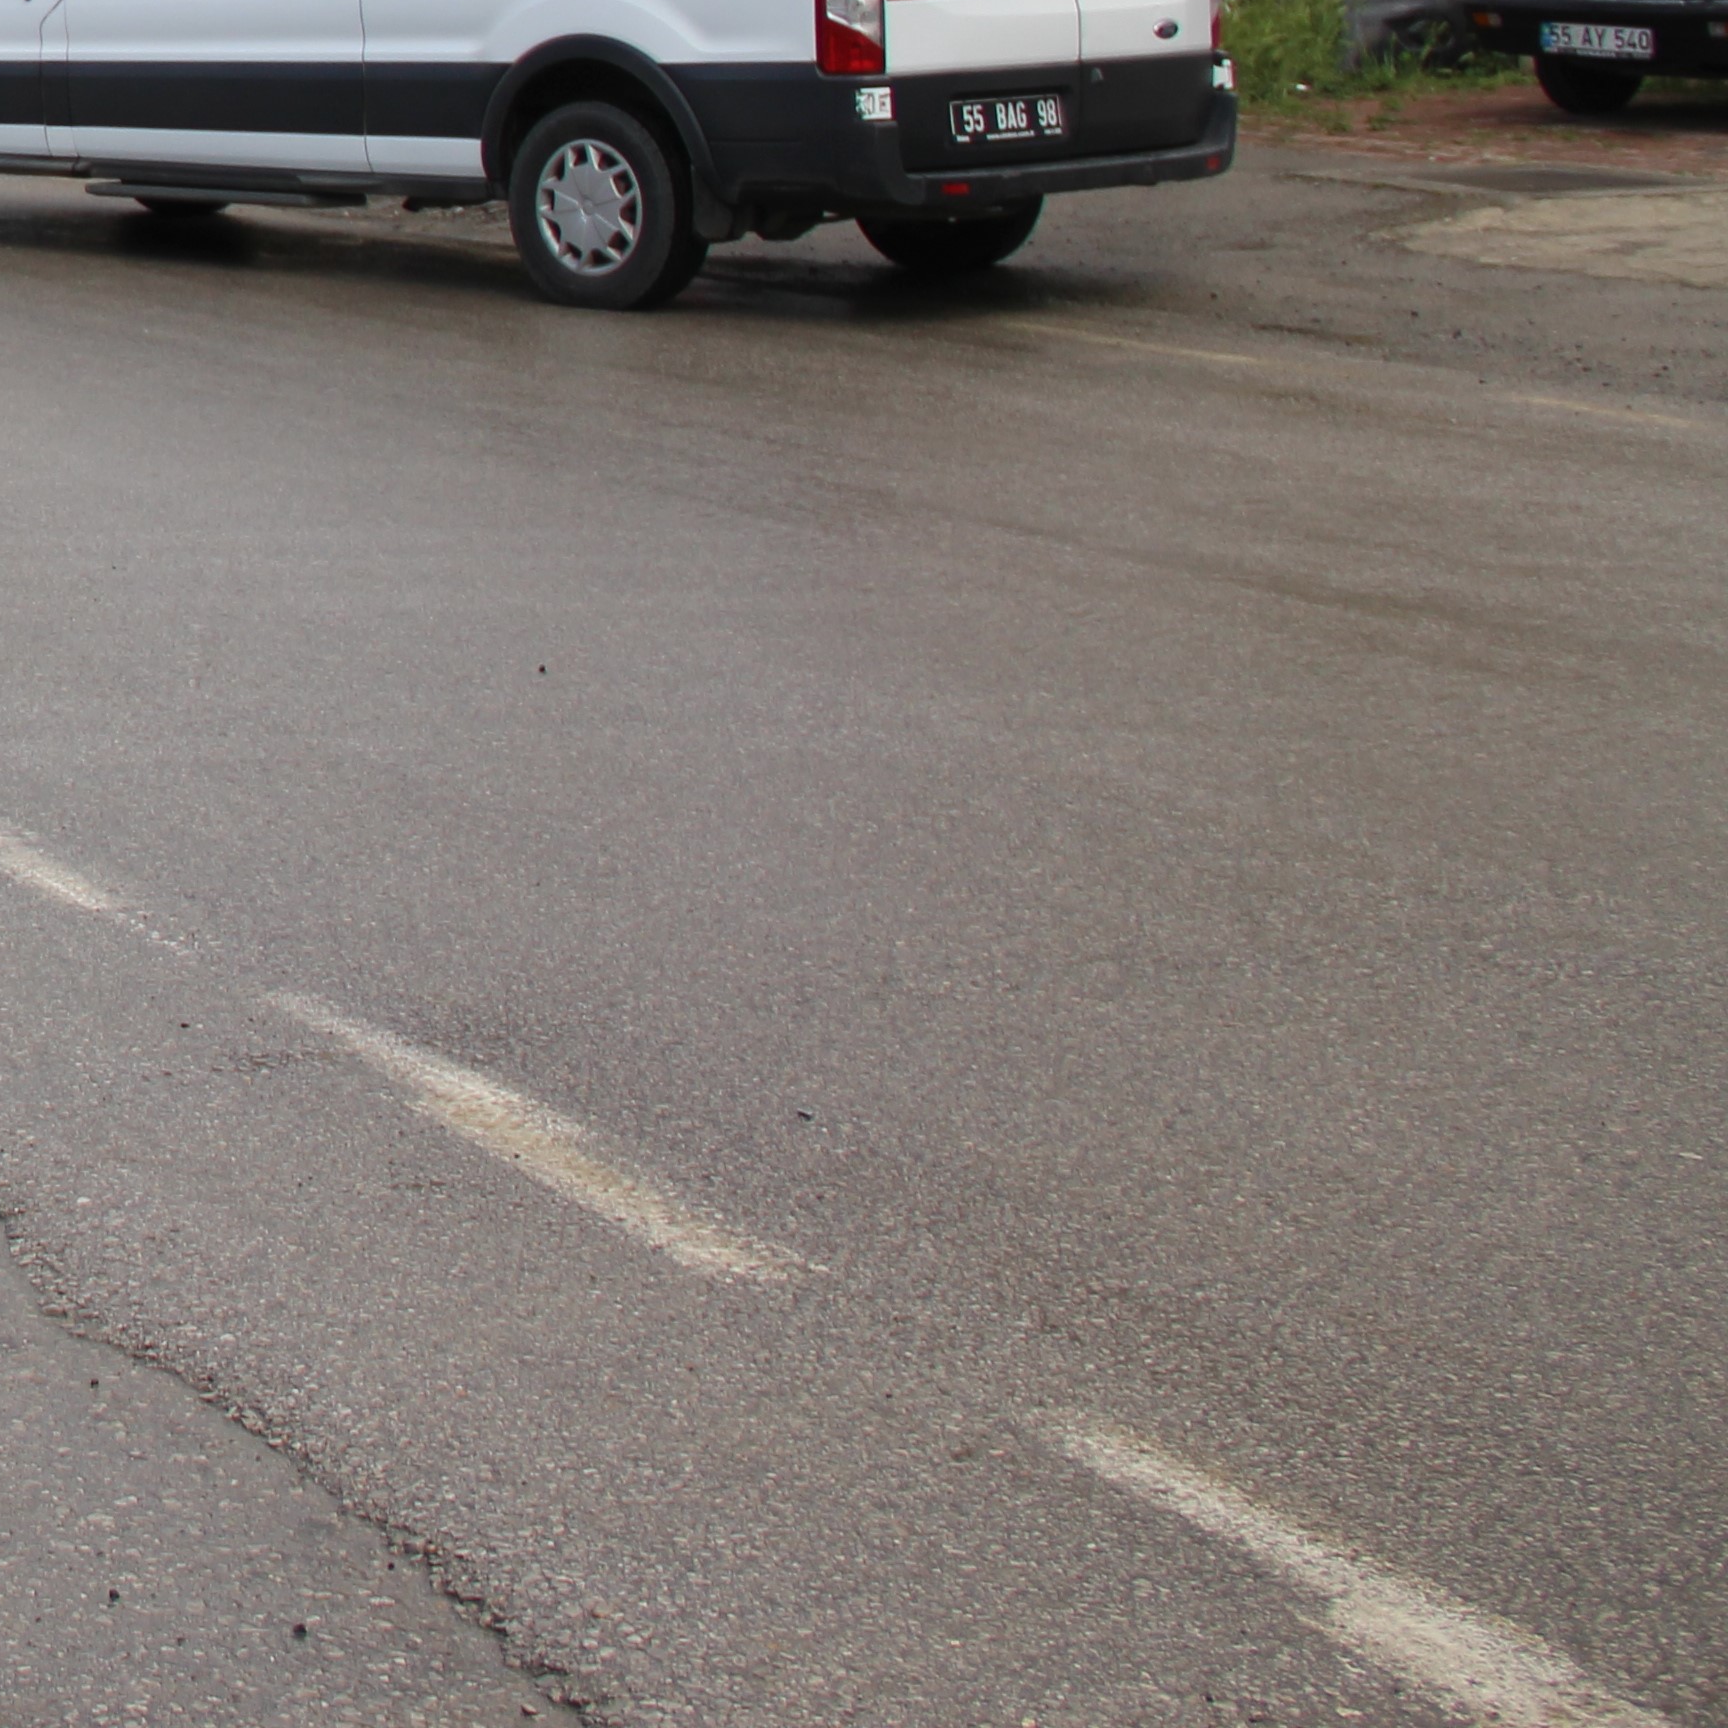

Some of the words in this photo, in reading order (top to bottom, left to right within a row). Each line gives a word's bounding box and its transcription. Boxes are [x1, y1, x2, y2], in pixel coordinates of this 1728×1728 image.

[1550, 24, 1572, 45] 55
[1581, 26, 1607, 48] AY
[1613, 29, 1650, 50] 540
[962, 104, 985, 132] 55
[995, 100, 1028, 130] BAG
[1037, 99, 1058, 127] 98
